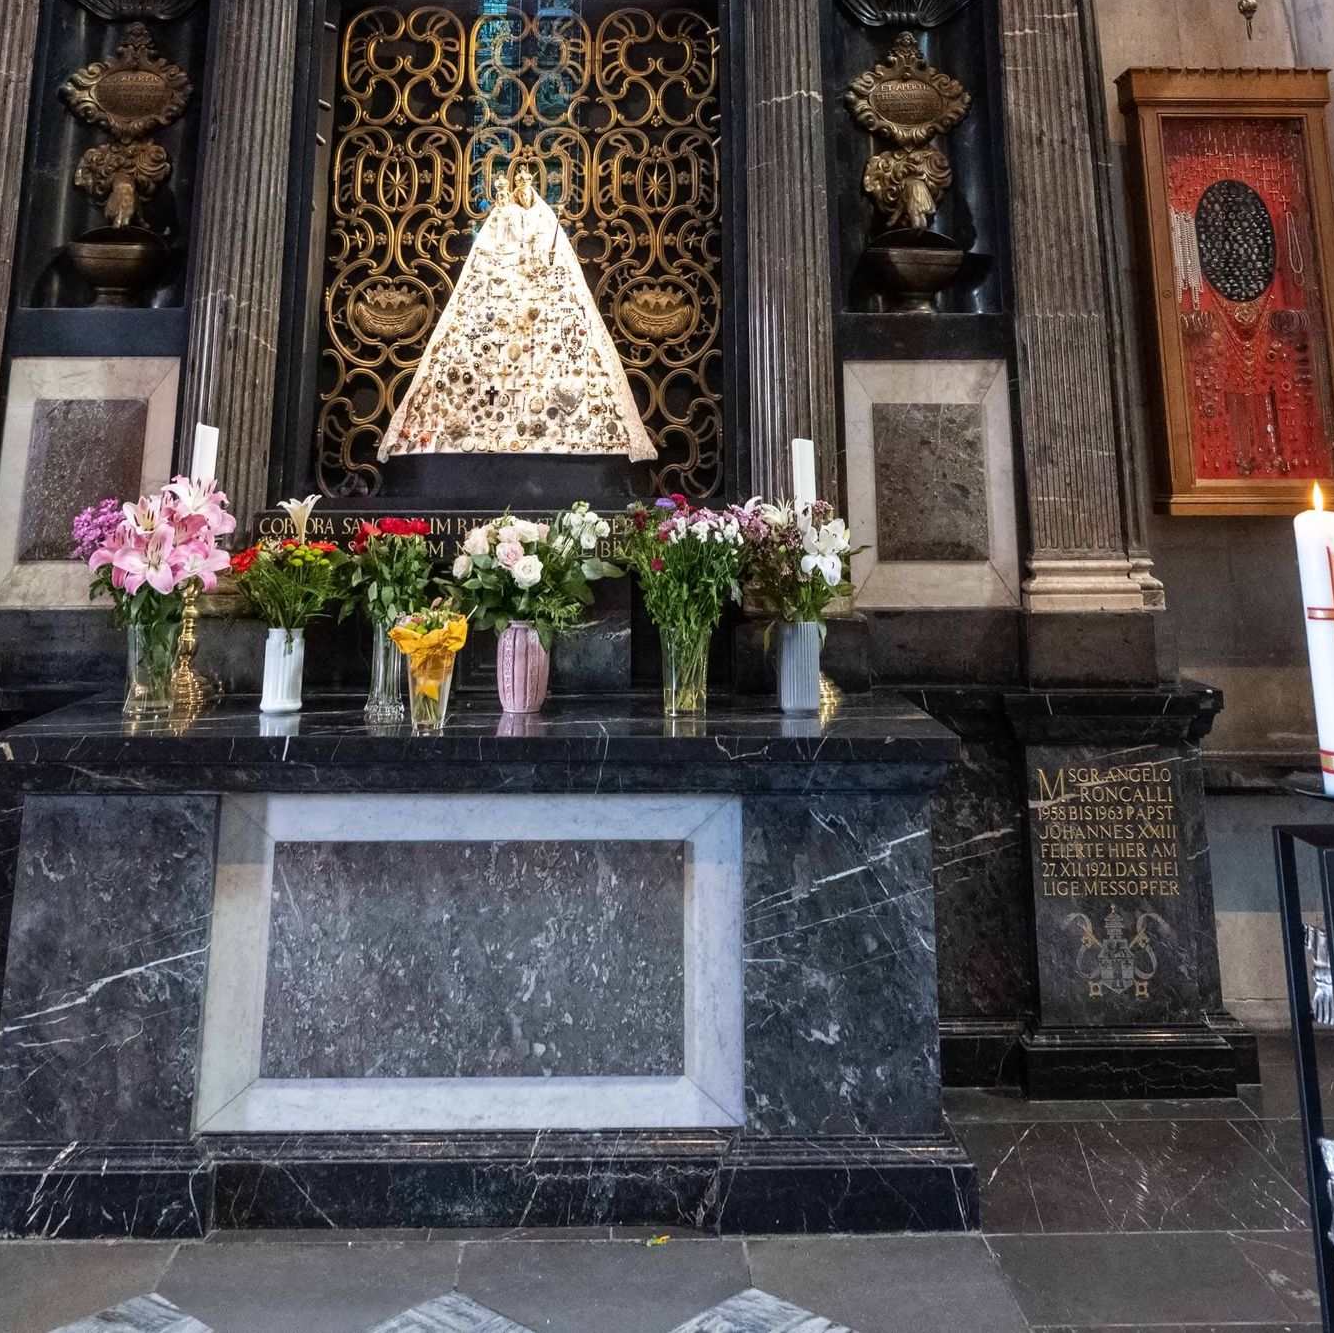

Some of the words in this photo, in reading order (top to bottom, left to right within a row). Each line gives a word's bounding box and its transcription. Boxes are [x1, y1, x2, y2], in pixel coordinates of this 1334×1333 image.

[259, 517, 334, 535] CORORA
[1080, 786, 1172, 802] RONCALLI
[1038, 806, 1066, 820] 1958
[1069, 806, 1092, 820] BIS
[1095, 806, 1123, 820] 1963
[1127, 806, 1174, 820] PAPST
[1039, 825, 1134, 839] JOHANNES
[1138, 825, 1176, 839] XXIII
[1041, 843, 1104, 858] FEIERTE
[1108, 843, 1146, 857] HIER
[1152, 843, 1177, 857] AM
[1116, 862, 1147, 876] DAS
[1152, 862, 1178, 876] HEI
[1044, 881, 1081, 896] LIGE
[1084, 881, 1179, 896] MESSOPFER
